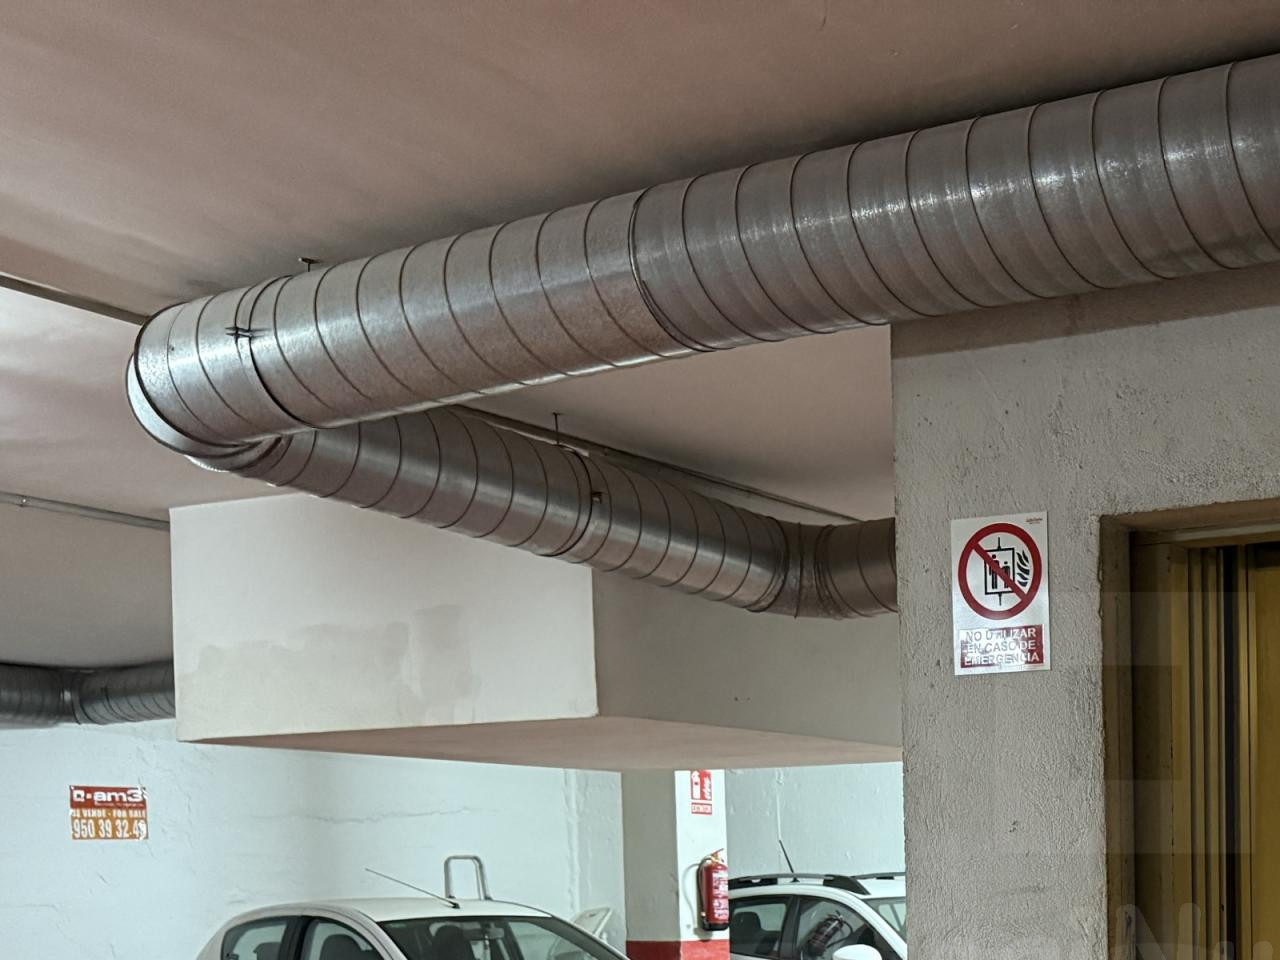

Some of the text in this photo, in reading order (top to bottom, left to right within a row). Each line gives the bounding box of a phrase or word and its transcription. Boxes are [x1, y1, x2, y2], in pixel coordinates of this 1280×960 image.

[966, 631, 982, 644] NO
[1019, 640, 1037, 650] DE
[964, 651, 1040, 666] EMERGENCIA
[73, 818, 96, 838] 950
[98, 818, 112, 838] 39
